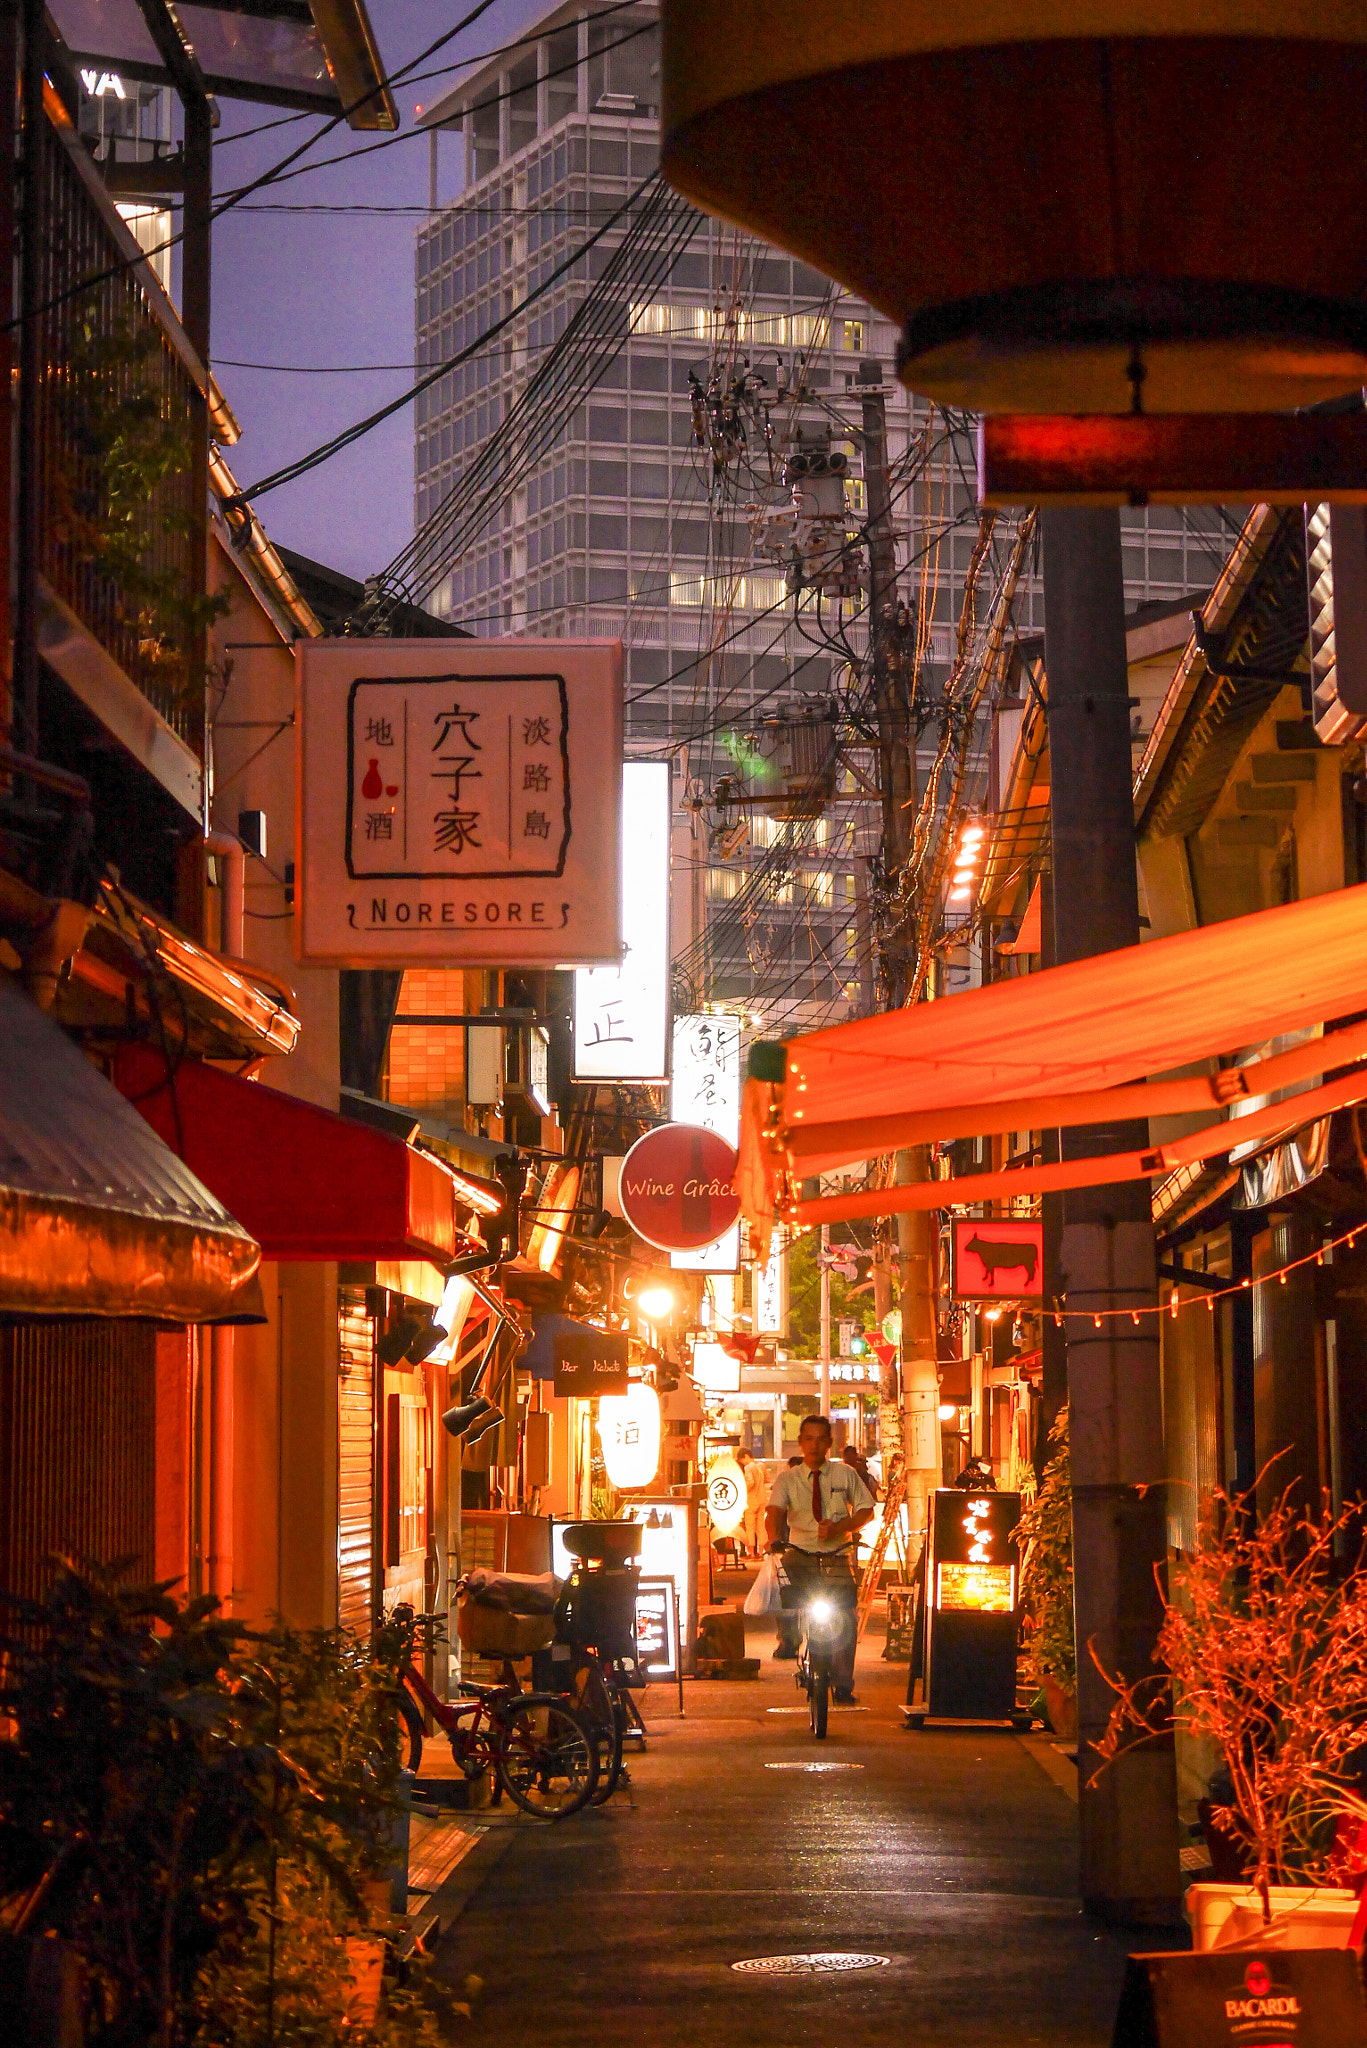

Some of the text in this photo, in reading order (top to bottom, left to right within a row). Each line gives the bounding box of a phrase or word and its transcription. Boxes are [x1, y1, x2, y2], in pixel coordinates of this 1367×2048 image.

[431, 703, 483, 855] 穴子家
[522, 716, 552, 840] 淡路島
[371, 897, 546, 923] NORESORE
[626, 1178, 675, 1197] Wine
[560, 1359, 579, 1373] Bar
[713, 1482, 731, 1505] 魚
[1224, 1996, 1299, 2018] BACARDI
